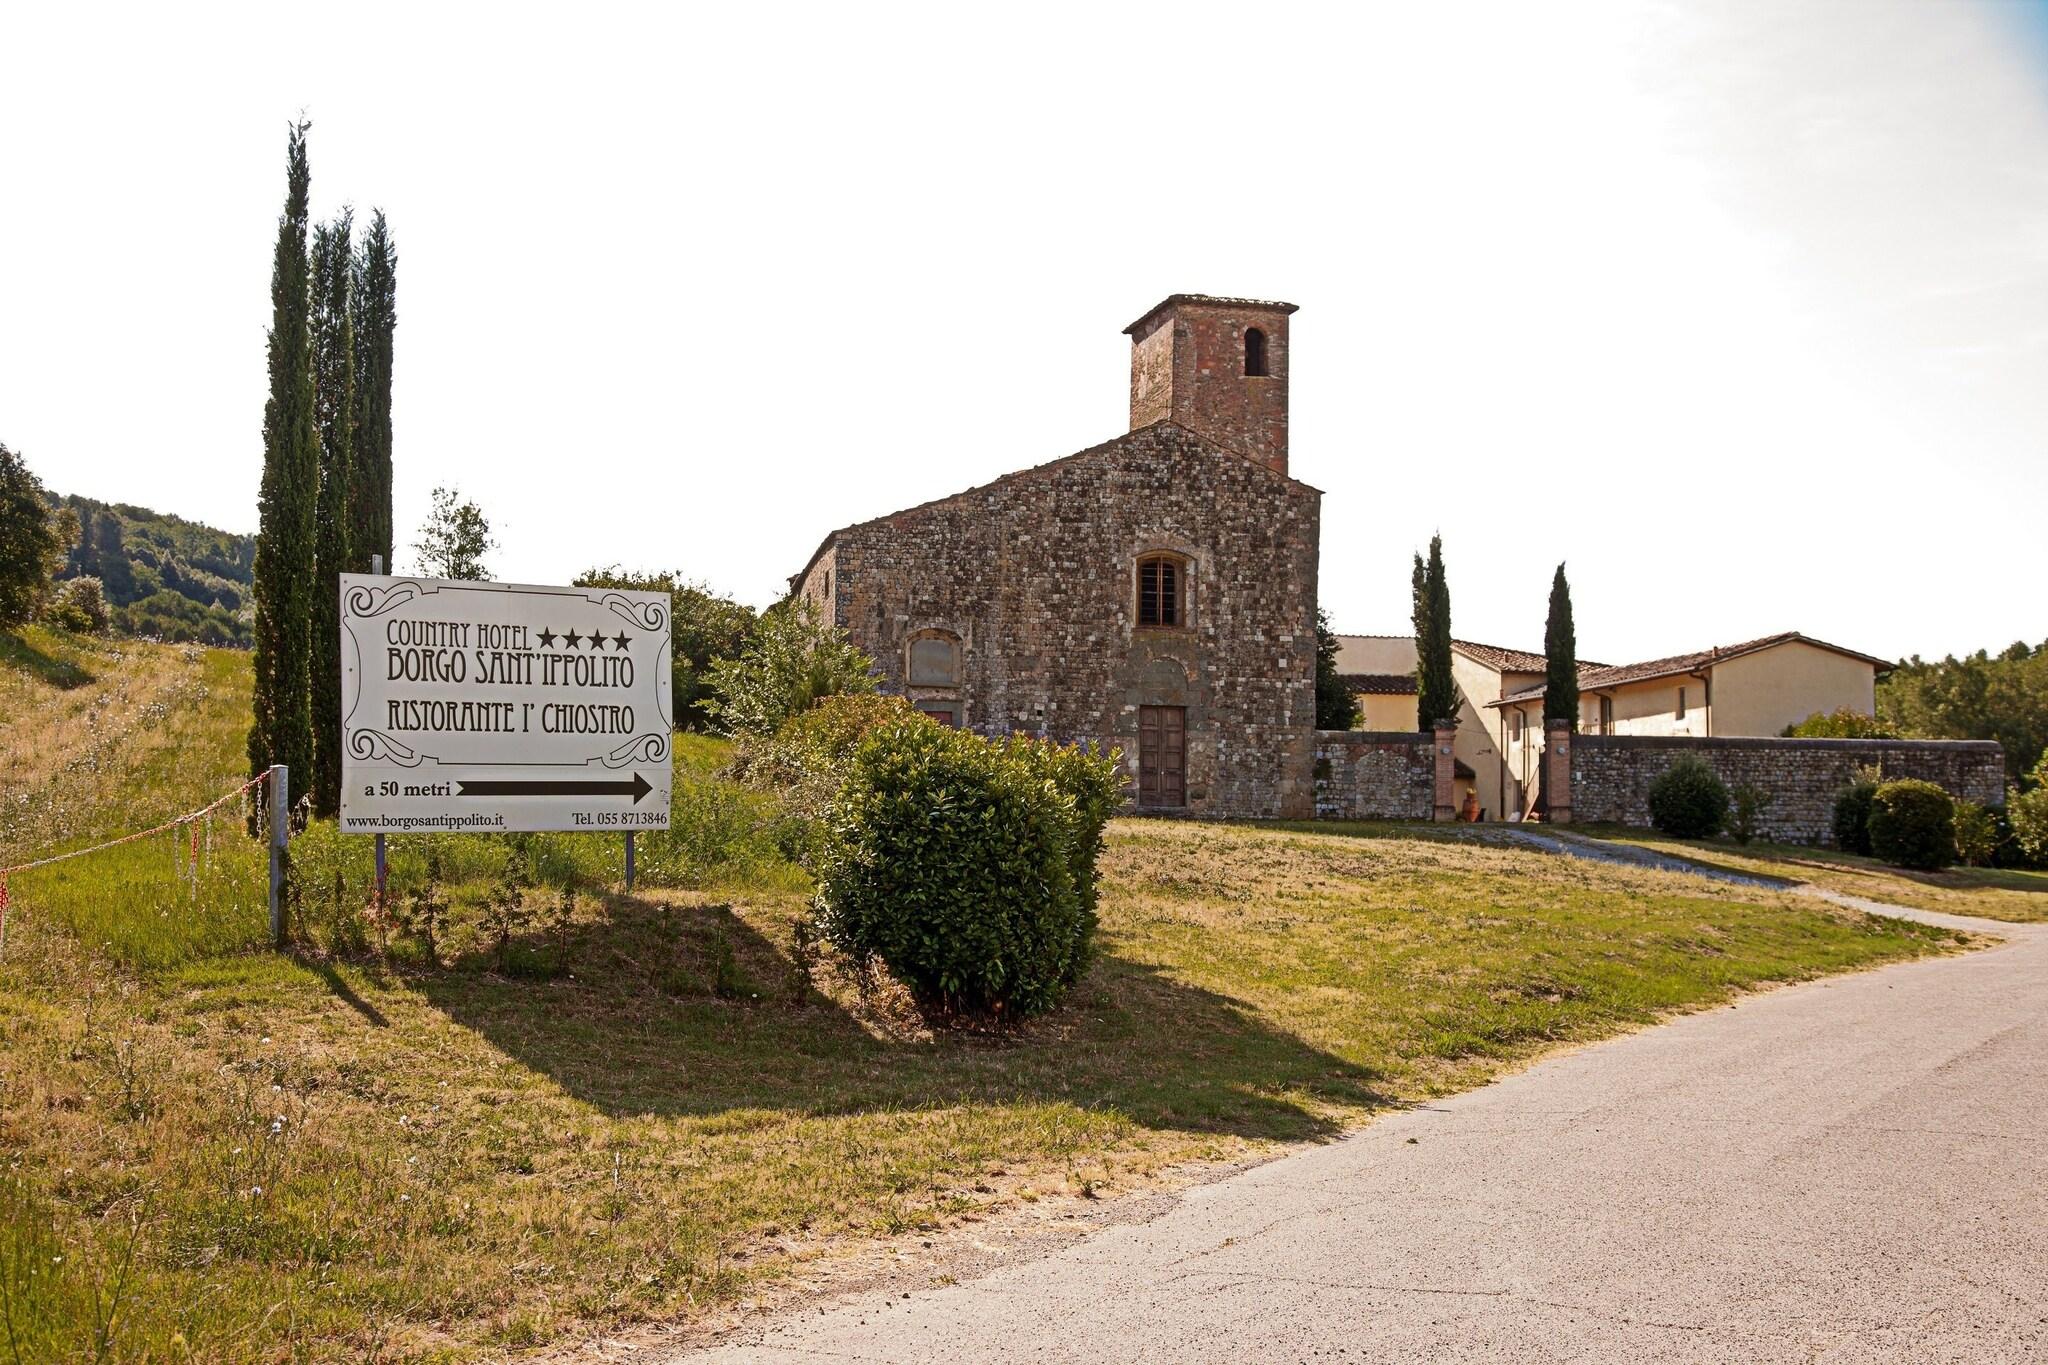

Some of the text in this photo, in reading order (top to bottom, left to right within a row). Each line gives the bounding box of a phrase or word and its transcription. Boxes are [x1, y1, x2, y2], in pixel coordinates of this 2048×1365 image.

[387, 619, 532, 651] COUNTRY HOTEL
[387, 648, 634, 688] BORGO SANT'IPPOLITO
[387, 700, 515, 732] RISTORANTE
[542, 704, 635, 734] CHIOSTRO
[364, 781, 451, 796] a 50 metri
[347, 813, 504, 830] www.borgosantippolito.it
[572, 812, 667, 825] Tel. 055 8713846
